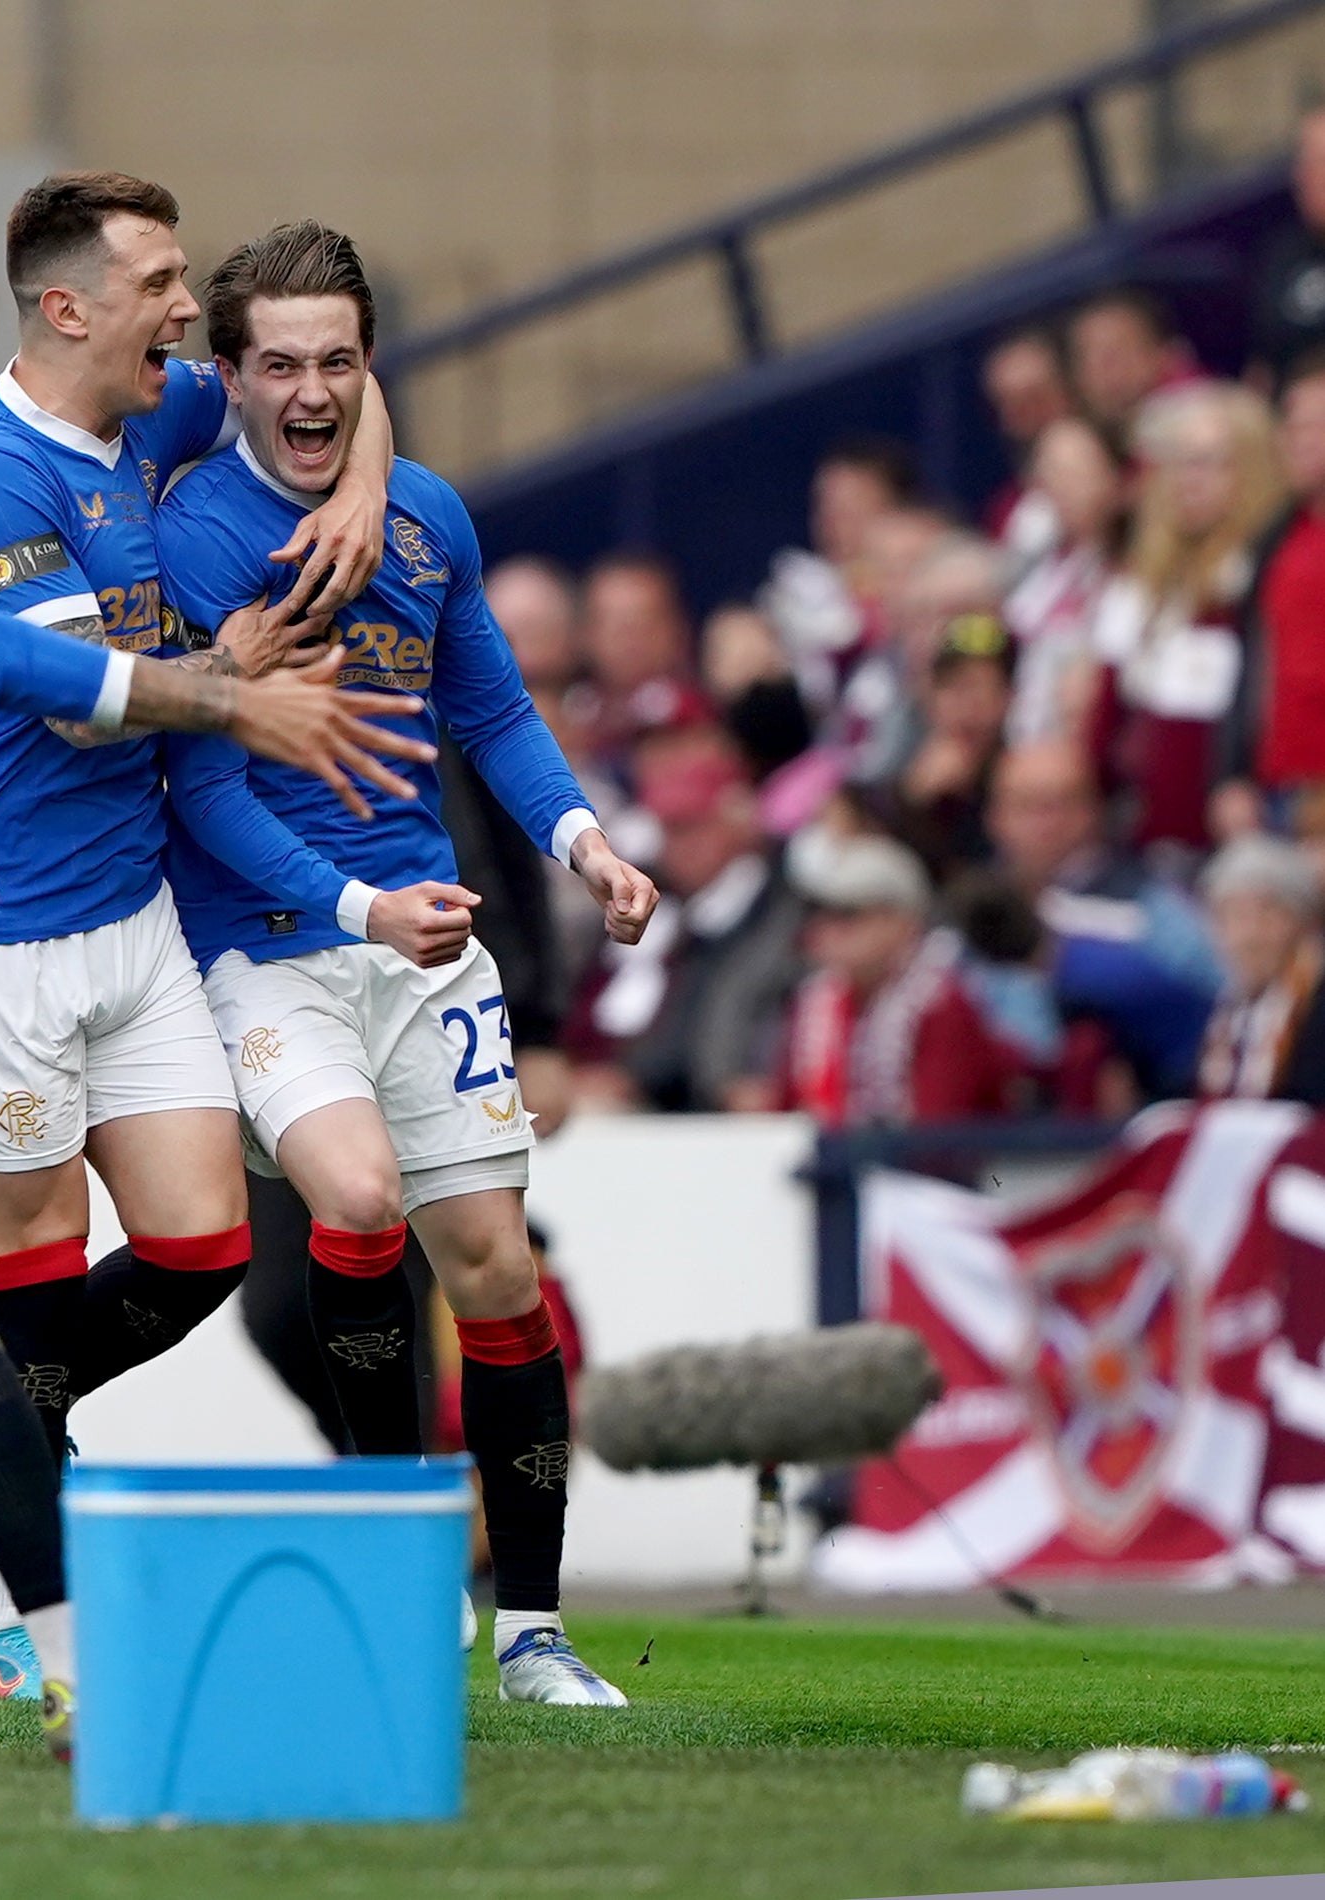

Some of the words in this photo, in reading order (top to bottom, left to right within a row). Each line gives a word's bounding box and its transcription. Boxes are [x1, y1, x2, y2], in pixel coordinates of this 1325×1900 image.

[34, 541, 60, 556] KDM
[118, 636, 136, 650] SET
[336, 671, 360, 684] SET
[441, 994, 516, 1093] 23
